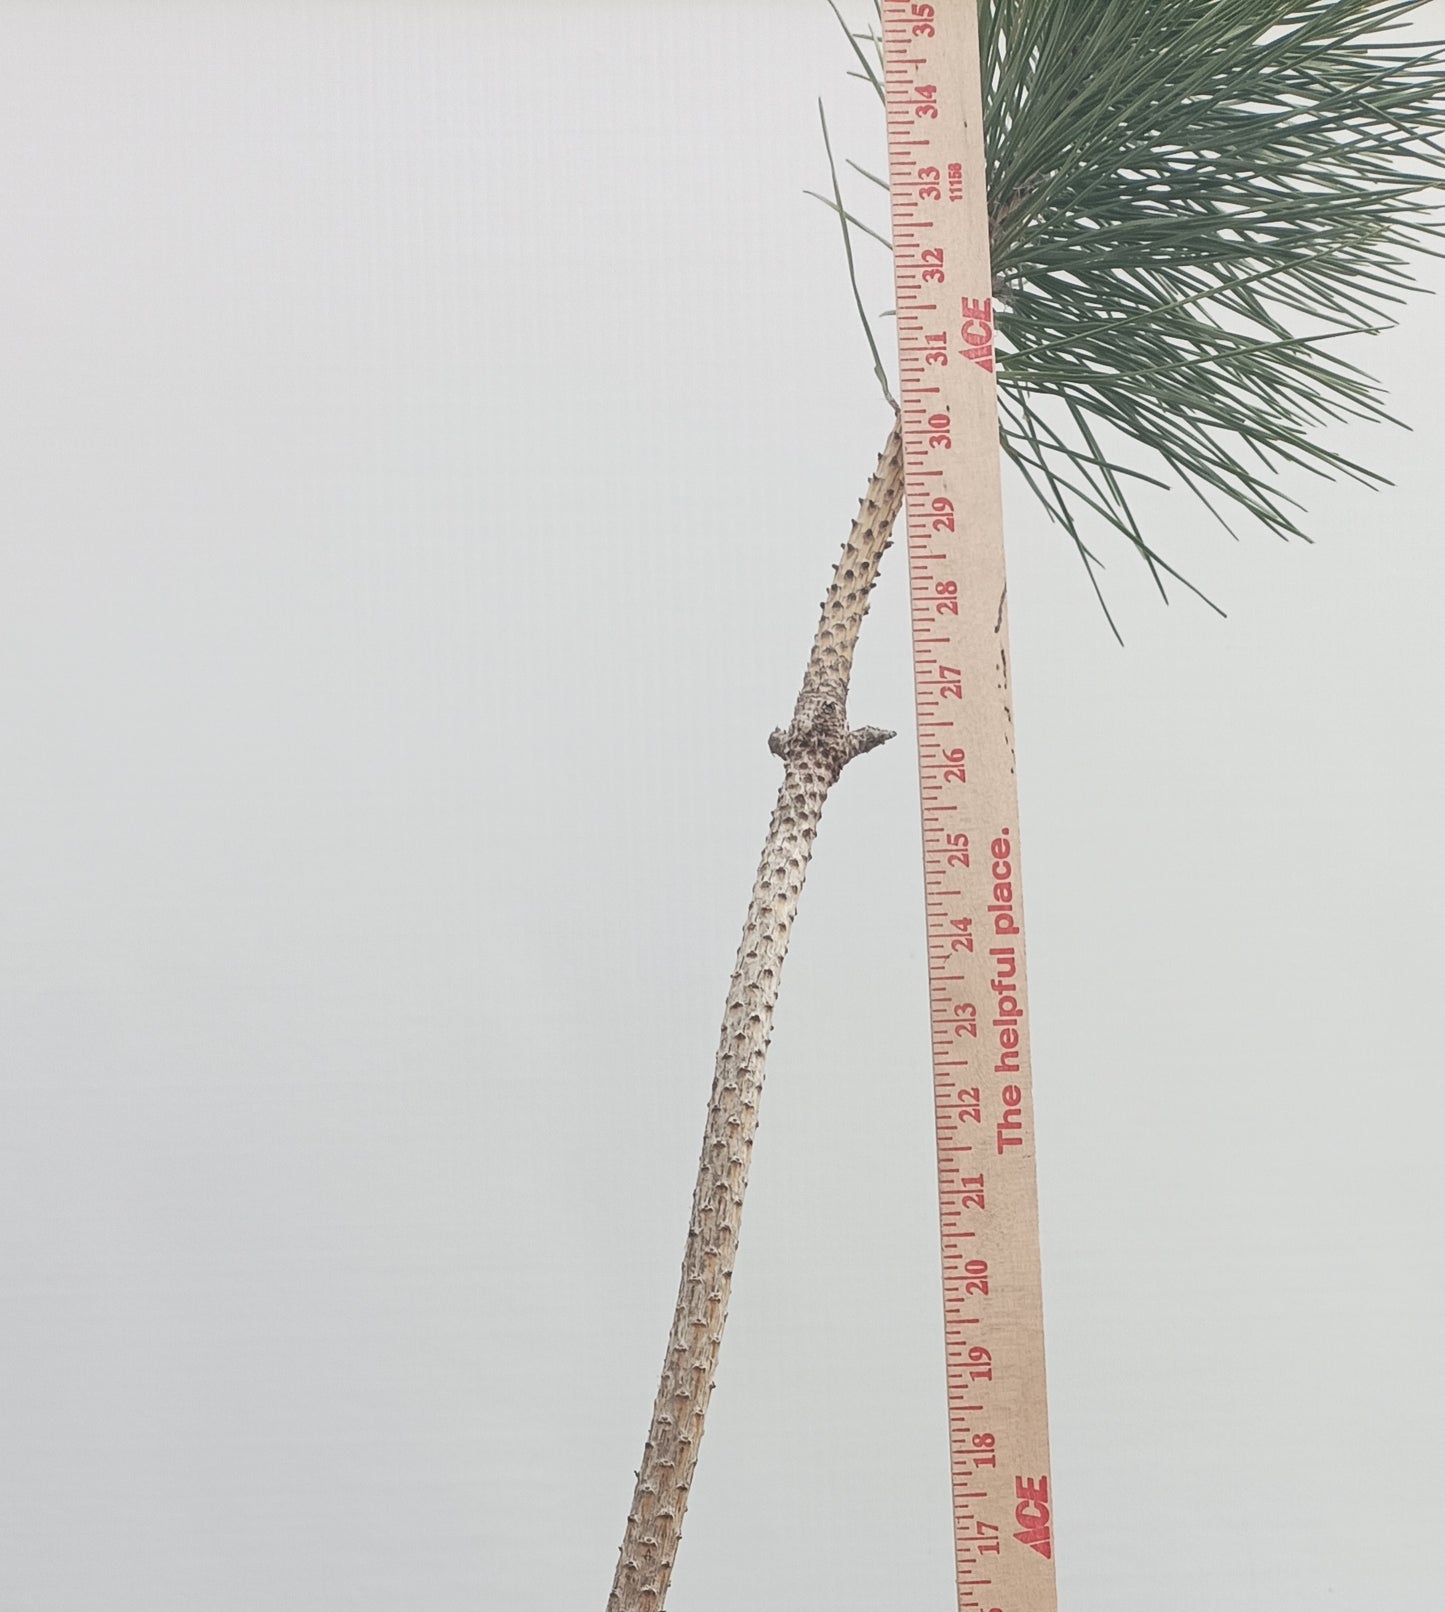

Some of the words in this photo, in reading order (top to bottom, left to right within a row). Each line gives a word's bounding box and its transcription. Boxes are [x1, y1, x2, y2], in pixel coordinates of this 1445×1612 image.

[912, 4, 935, 38] 35
[915, 84, 938, 119] 34
[918, 166, 941, 201] 33
[922, 248, 944, 283] 32
[925, 331, 948, 366] 31
[958, 297, 993, 373] ACE
[928, 414, 951, 450] 30
[932, 497, 955, 533] 29
[935, 580, 958, 615] 28
[939, 665, 962, 700] 27
[943, 748, 966, 783] 26
[947, 833, 970, 868] 25
[988, 827, 1020, 935] place.
[951, 917, 974, 953] 24
[954, 1002, 977, 1038] 23
[989, 947, 1023, 1073] helpful
[958, 1087, 981, 1123] 22
[997, 1084, 1023, 1154] The
[962, 1173, 985, 1210] 21
[965, 1259, 989, 1295] 20
[968, 1346, 993, 1381] 19
[972, 1432, 996, 1468] 18
[1013, 1475, 1052, 1559] ACE
[976, 1520, 999, 1555] 17
